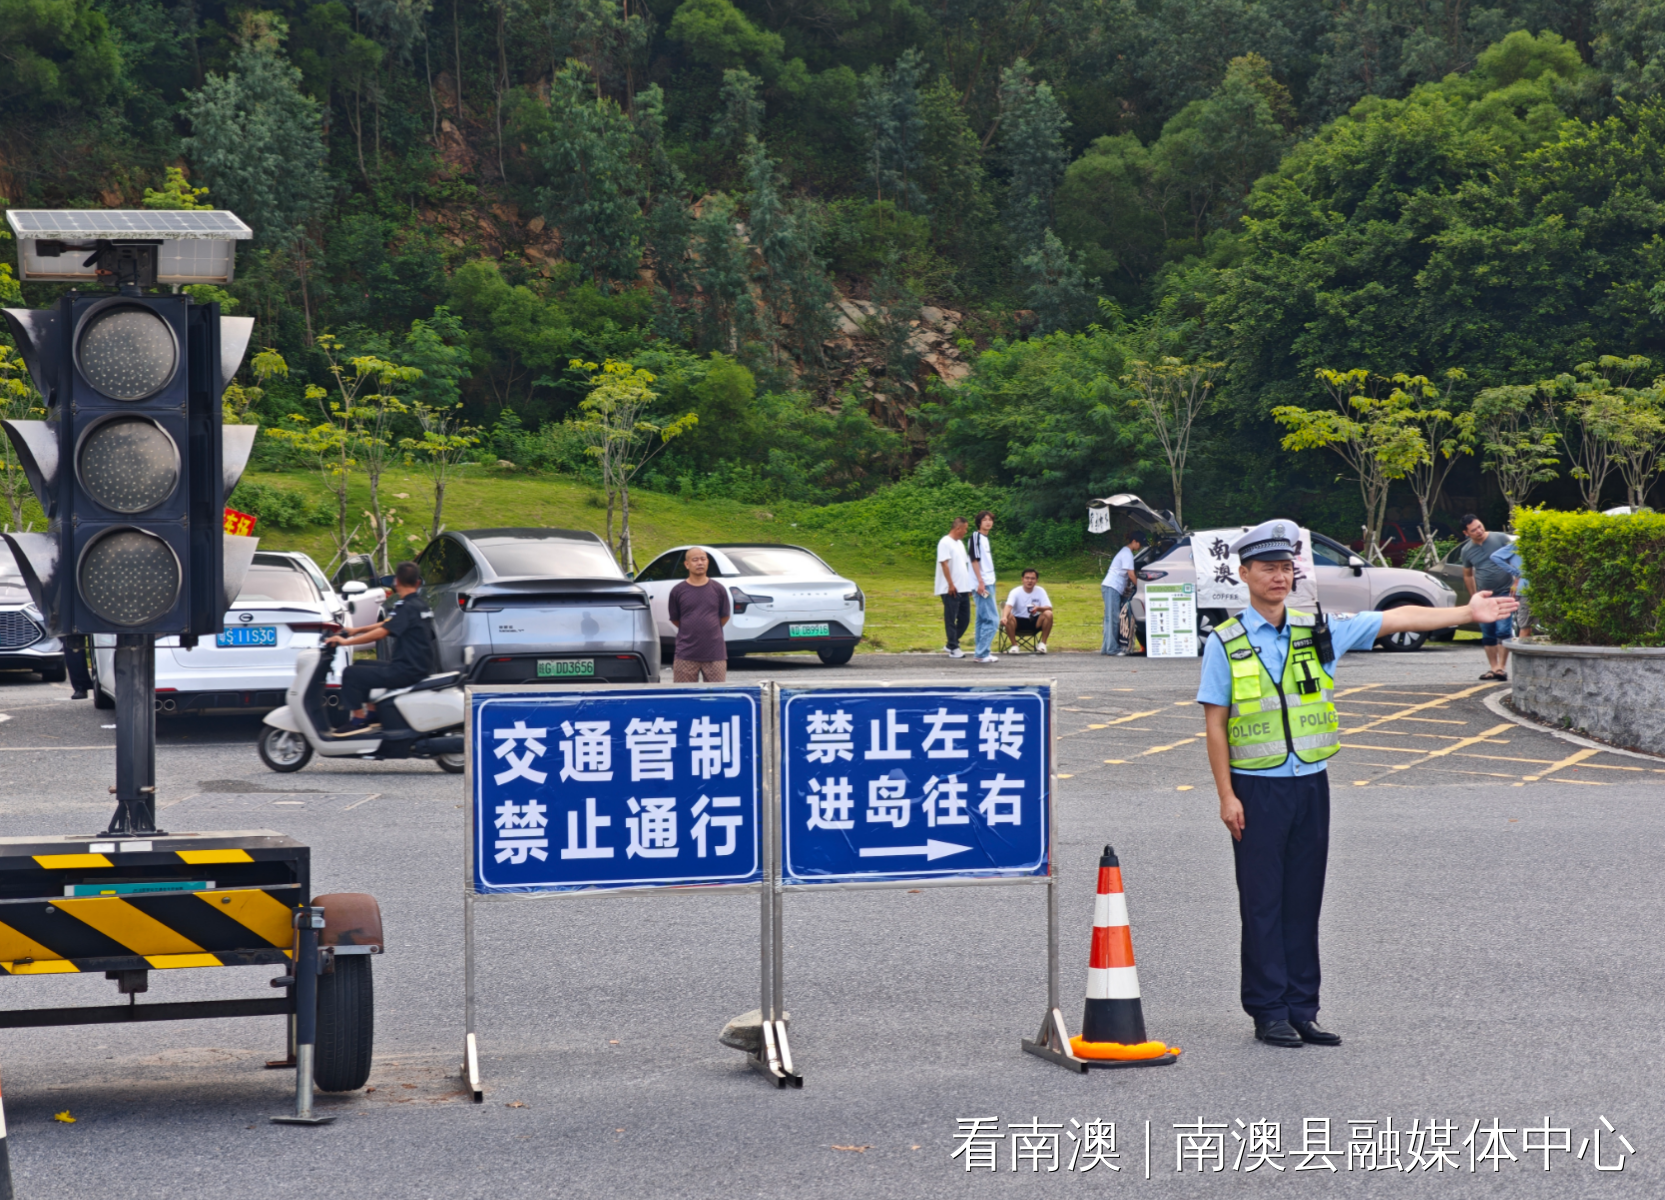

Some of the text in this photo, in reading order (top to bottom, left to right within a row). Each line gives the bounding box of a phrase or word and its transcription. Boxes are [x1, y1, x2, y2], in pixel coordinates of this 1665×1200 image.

[223, 513, 252, 536] 车场
[1208, 537, 1240, 587] 南澳
[493, 714, 742, 786] 交通管制
[805, 706, 1026, 764] 禁止左转
[1231, 722, 1271, 739] OLICE
[493, 796, 744, 865] 禁止通行
[805, 773, 1026, 831] 进岛往右
